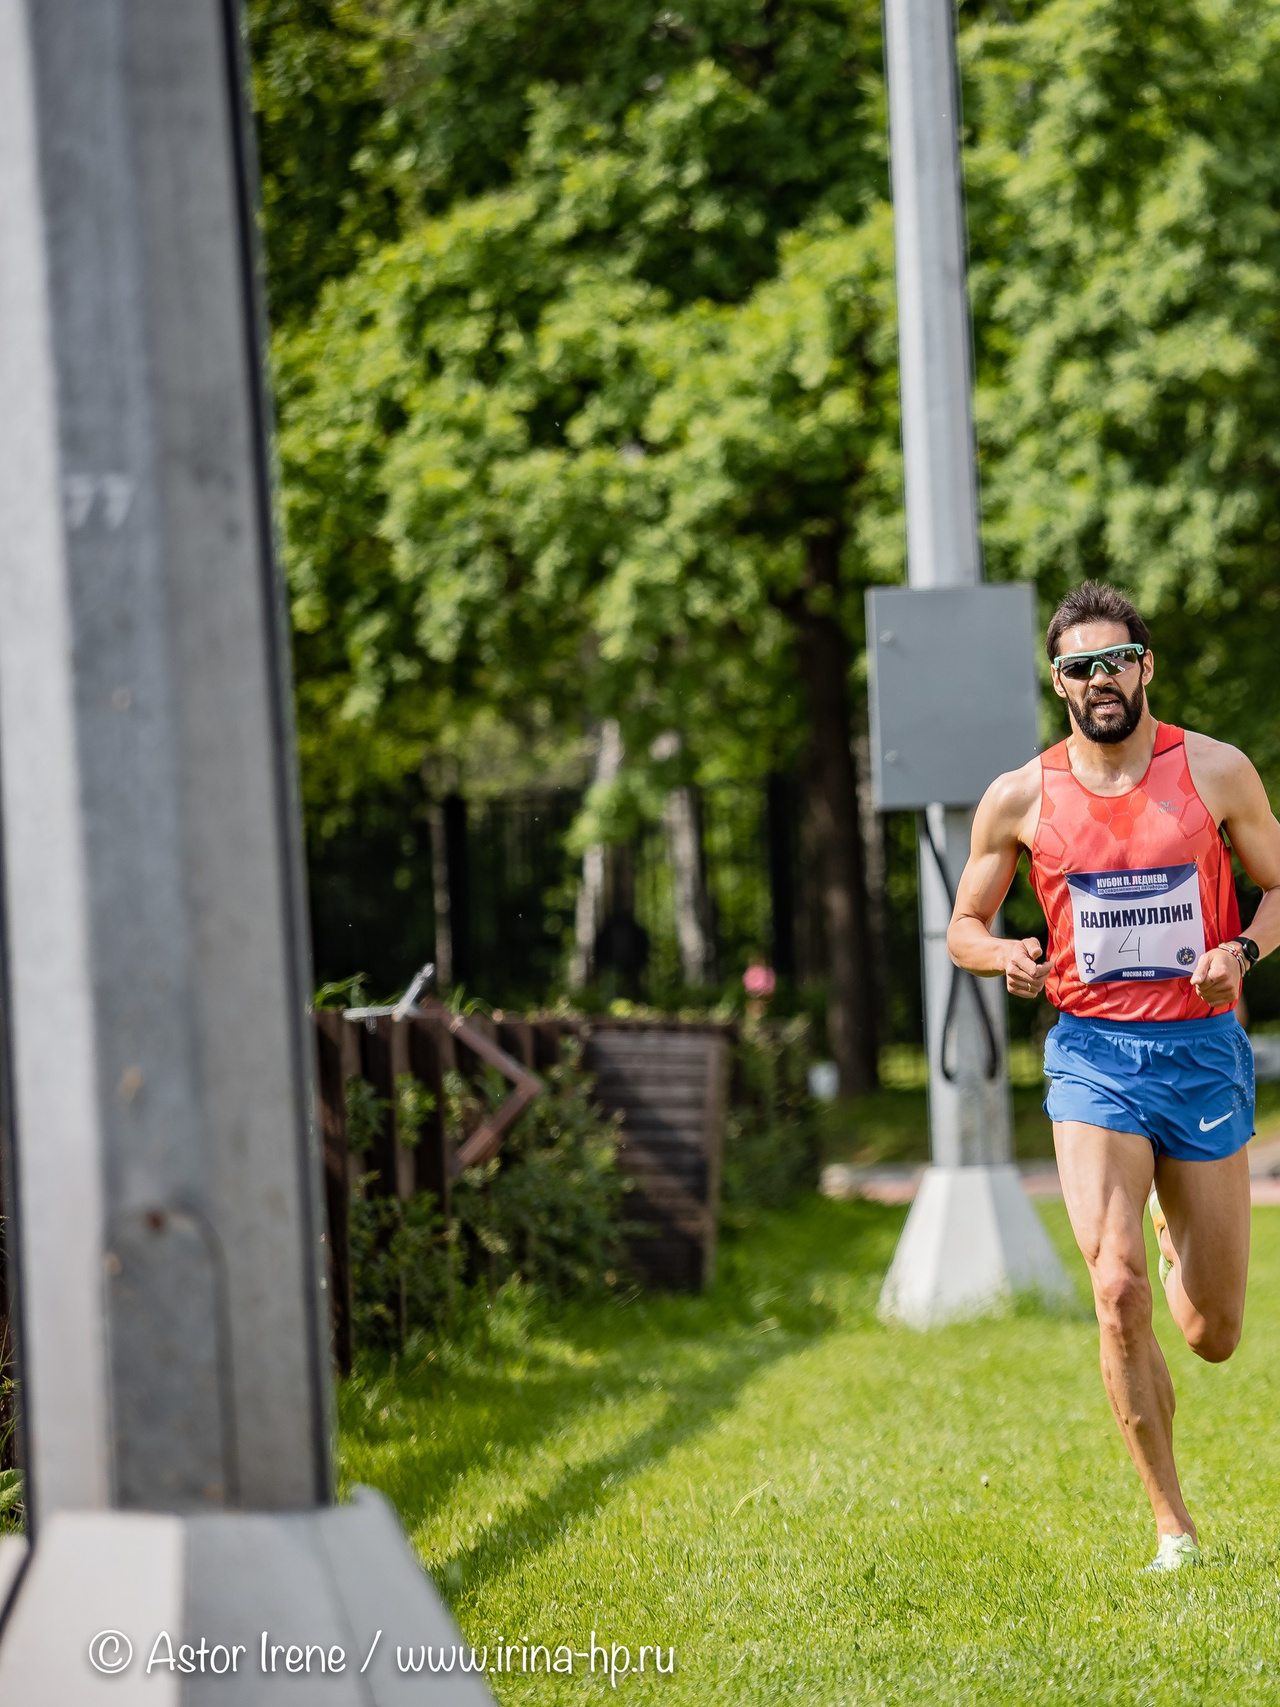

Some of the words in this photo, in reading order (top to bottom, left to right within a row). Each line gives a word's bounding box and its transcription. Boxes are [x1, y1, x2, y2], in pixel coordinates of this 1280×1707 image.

[1097, 877, 1122, 888] КУБОК
[1123, 876, 1131, 886] П.
[1132, 874, 1167, 885] ЛЕДНЕВА
[1080, 903, 1194, 928] КАЛИМУЛЛИН
[1118, 929, 1141, 962] 4
[1122, 970, 1142, 978] МОСКВА
